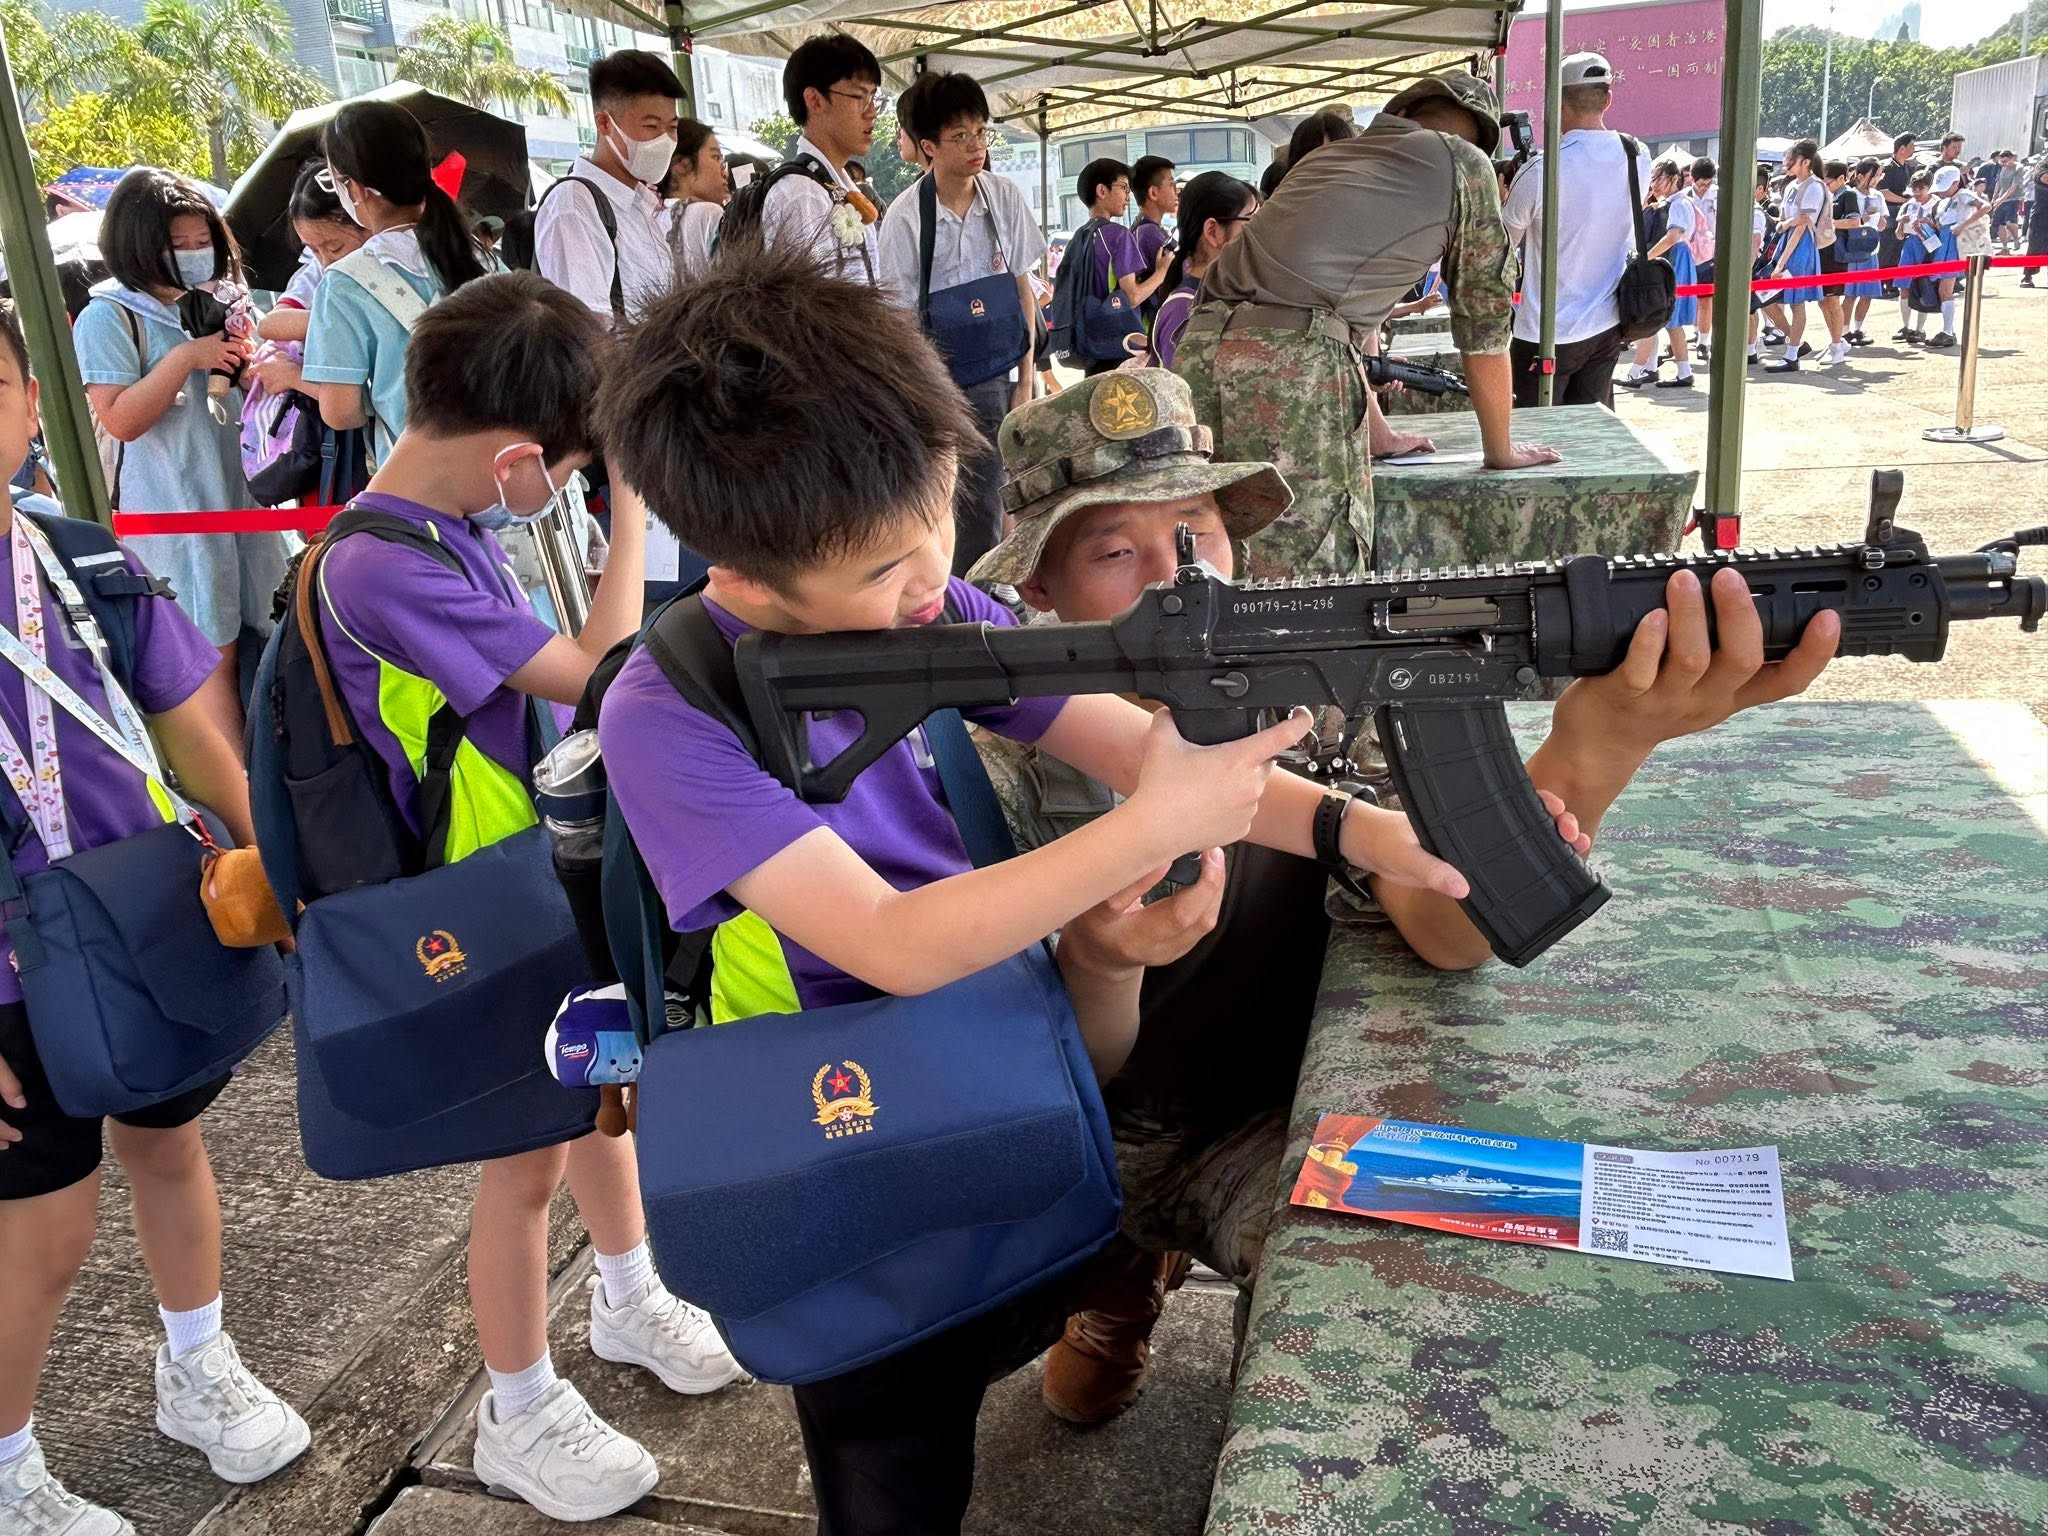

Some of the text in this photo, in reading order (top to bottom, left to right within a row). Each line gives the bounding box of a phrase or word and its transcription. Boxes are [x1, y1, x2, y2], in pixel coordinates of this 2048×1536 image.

[1233, 596, 1334, 614] 090779-21-296
[559, 1043, 588, 1055] Tempo
[1714, 1153, 1760, 1165] 007179
